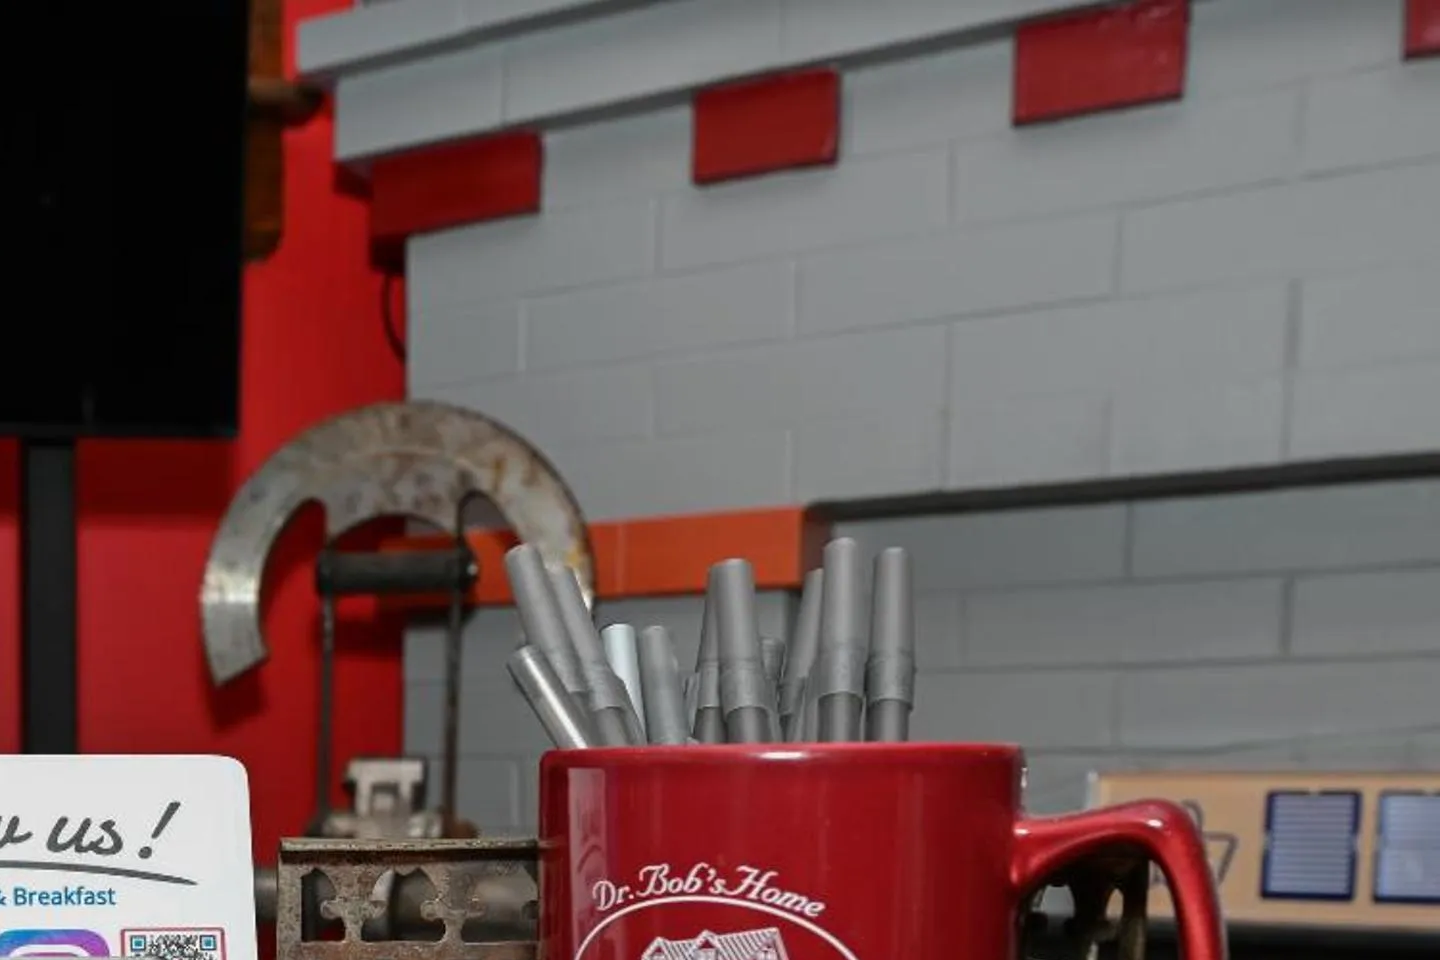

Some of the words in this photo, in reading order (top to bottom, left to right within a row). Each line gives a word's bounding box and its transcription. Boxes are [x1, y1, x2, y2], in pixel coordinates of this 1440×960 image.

[13, 885, 117, 907] Breakfast
[591, 879, 634, 911] Dr.
[637, 861, 726, 896] Bob's
[722, 864, 826, 918] Home
